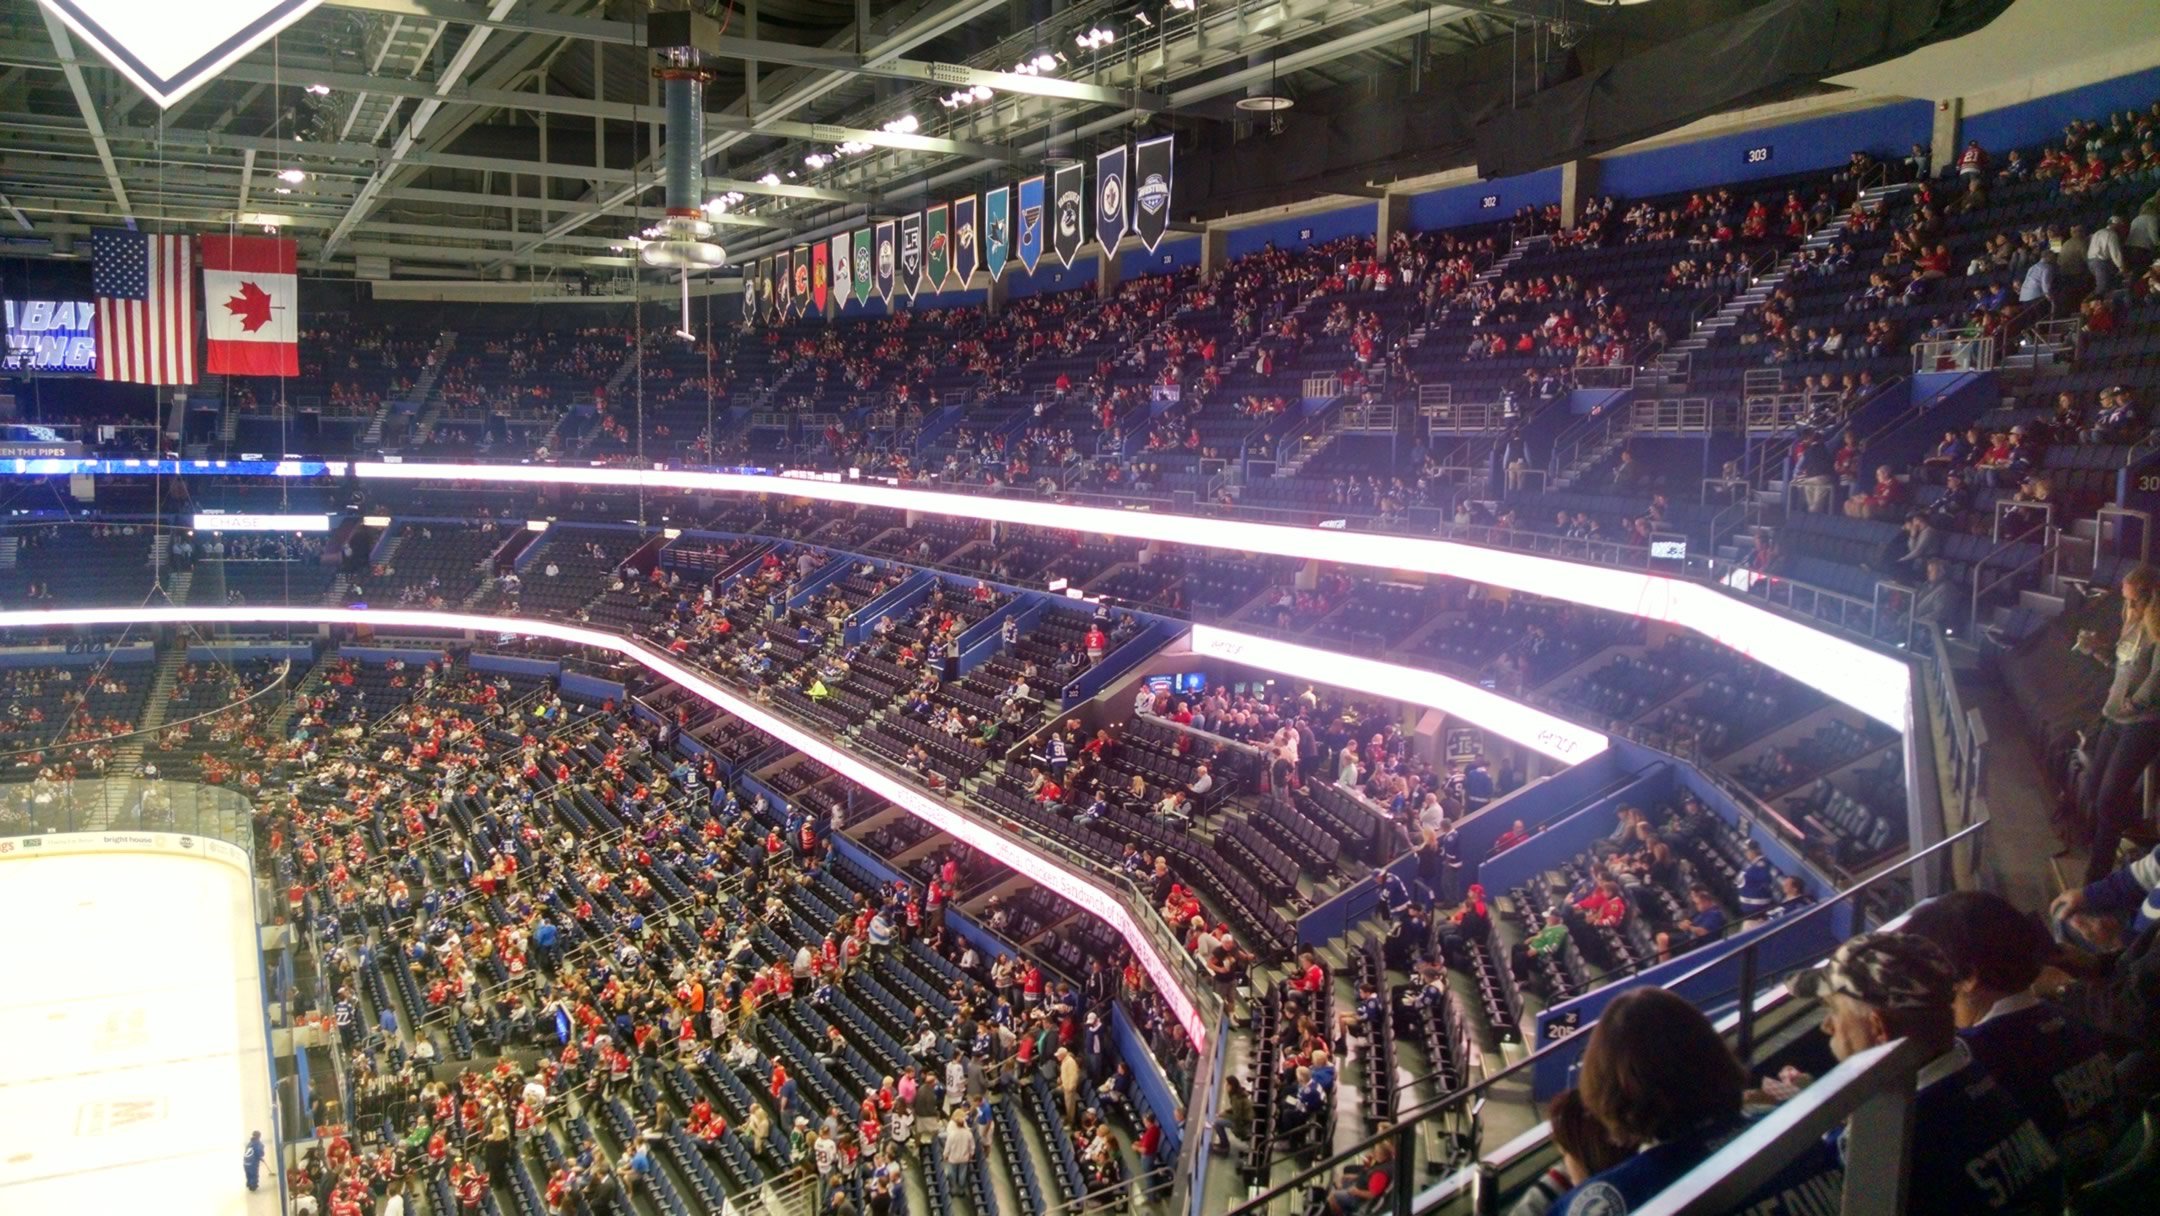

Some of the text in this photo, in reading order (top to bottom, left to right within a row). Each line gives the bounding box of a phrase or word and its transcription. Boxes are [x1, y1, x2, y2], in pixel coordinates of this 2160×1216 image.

[1748, 148, 1767, 162] 303
[1483, 196, 1497, 208] 302
[21, 301, 95, 331] BAY
[17, 448, 37, 456] THE
[39, 448, 65, 456] PIPES
[209, 517, 259, 527] CHASE
[1091, 637, 1097, 647] 2
[1055, 744, 1065, 755] 91
[1458, 740, 1472, 754] 15
[103, 836, 128, 844] bright
[1060, 877, 1106, 913] Sandwich
[336, 1012, 349, 1022] 77
[893, 1120, 902, 1136] 2
